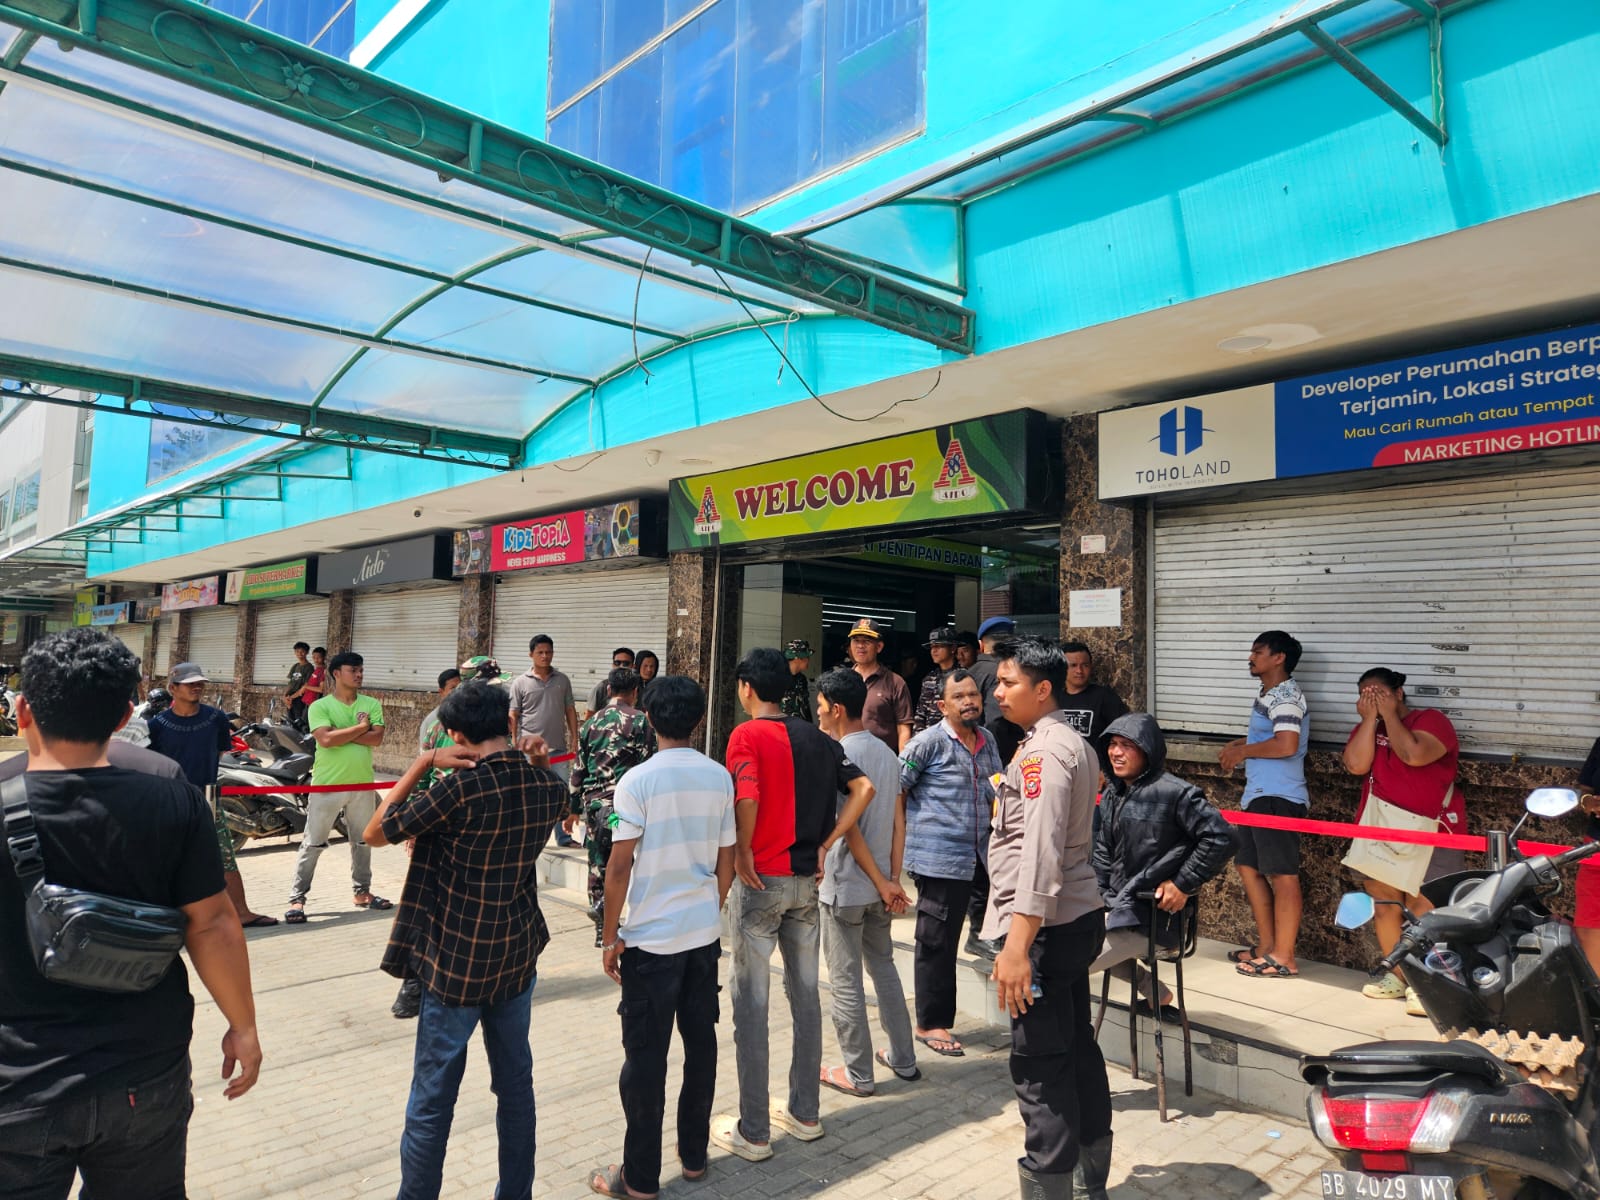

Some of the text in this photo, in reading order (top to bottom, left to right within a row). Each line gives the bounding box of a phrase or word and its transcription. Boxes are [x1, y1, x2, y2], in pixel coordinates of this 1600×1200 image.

[1302, 335, 1600, 399] Developer Perumahan Berp
[1340, 389, 1438, 416] Terjamin,
[1443, 374, 1515, 400] Lokasi
[1344, 393, 1595, 439] Mau Cari Rumah atau Tempat
[1404, 434, 1523, 463] MARKETING
[734, 459, 915, 520] WELCOME
[1136, 460, 1231, 484] TOHOLAND
[1322, 1173, 1449, 1200] BB 4029 MY
